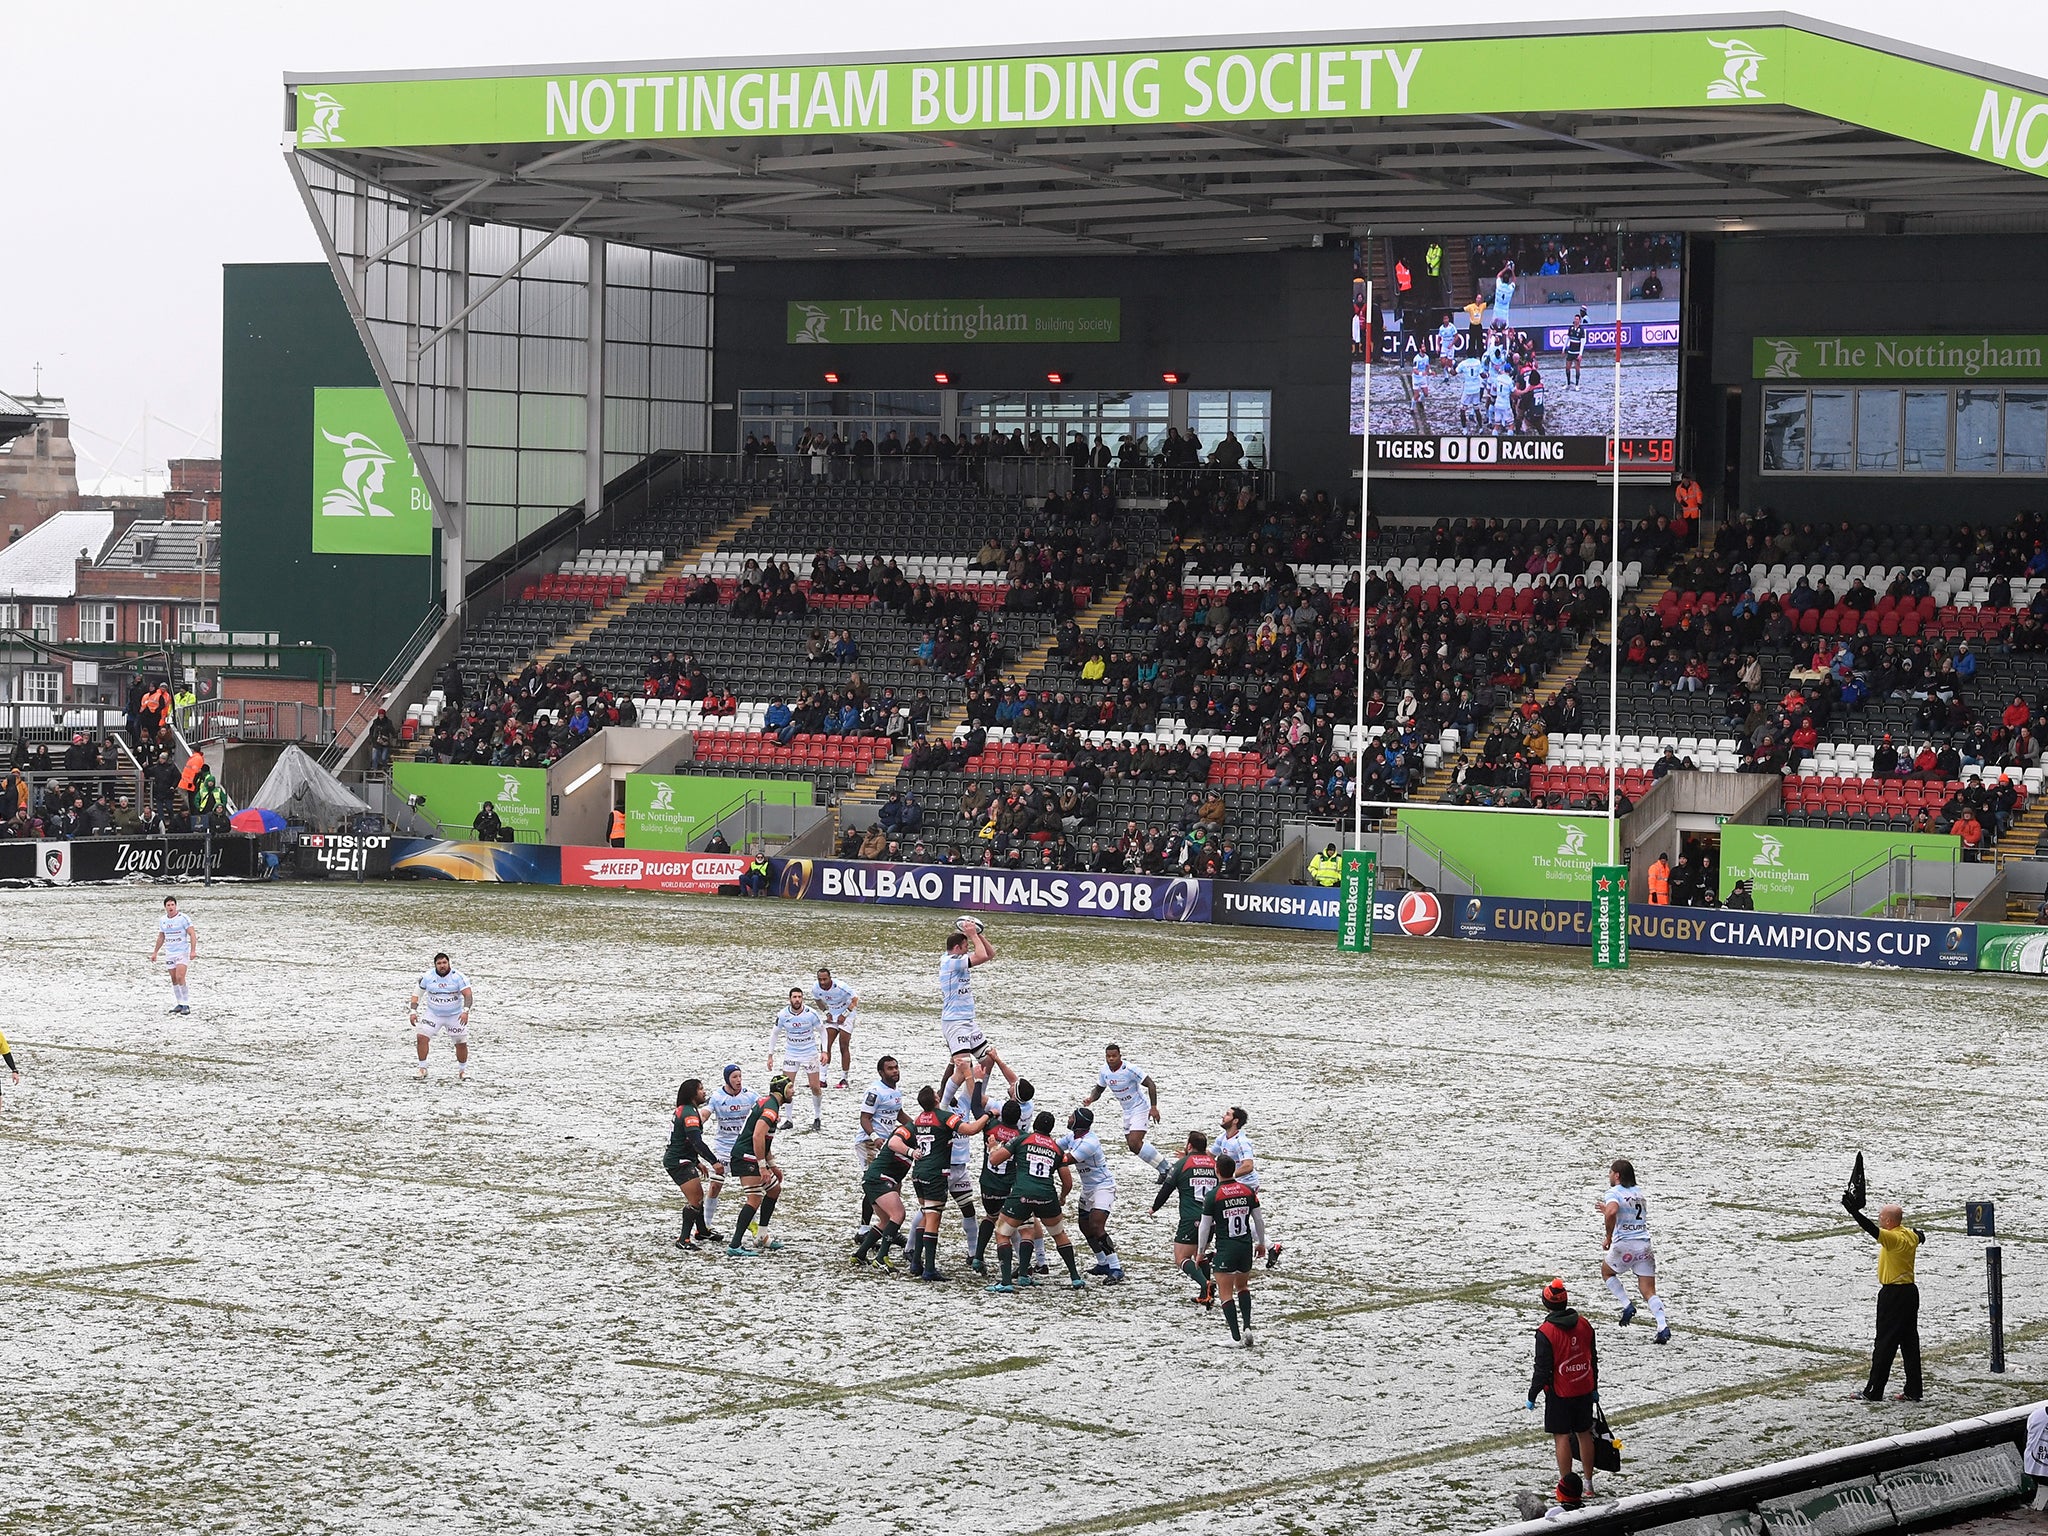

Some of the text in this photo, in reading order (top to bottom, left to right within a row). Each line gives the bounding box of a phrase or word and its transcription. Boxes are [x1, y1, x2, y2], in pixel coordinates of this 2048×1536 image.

[546, 48, 1423, 135] NOTTINGHAM BUILDING SOCIETY
[840, 304, 1113, 339] The Nottingham Building Society
[1588, 331, 1628, 343] SPORS
[1814, 338, 2043, 376] The Nottingham
[1376, 440, 1435, 459] TIGERS
[1448, 441, 1460, 460] 0
[1478, 441, 1490, 460] 0
[1502, 441, 1564, 460] RACING
[495, 803, 540, 816] Nottingham
[630, 810, 695, 825] The Nottingham
[641, 823, 683, 835] Building Society
[324, 835, 390, 849] TISSOT
[114, 844, 162, 871] Zeus
[1533, 855, 1551, 867] The
[1554, 857, 1609, 871] Nottingh
[600, 862, 735, 876] #KEEP RUGBY CLEAN
[1546, 870, 1592, 882] Building Socie
[1727, 866, 1809, 883] The Nottingham
[822, 867, 1153, 911] BILBAO FINALS 2018
[1770, 882, 1794, 895] Society
[1223, 893, 1395, 921] TURKISH AIRES
[1344, 876, 1359, 947] Heineken
[1494, 908, 1931, 956] EUROPE RUGBY CHAMPIONS CUP
[1598, 896, 1610, 963] Heineken
[1036, 1162, 1044, 1176] 8
[1191, 1178, 1216, 1186] Fischer
[1225, 1207, 1248, 1217] Fischer
[1635, 1203, 1643, 1220] 2
[1234, 1216, 1242, 1235] 9
